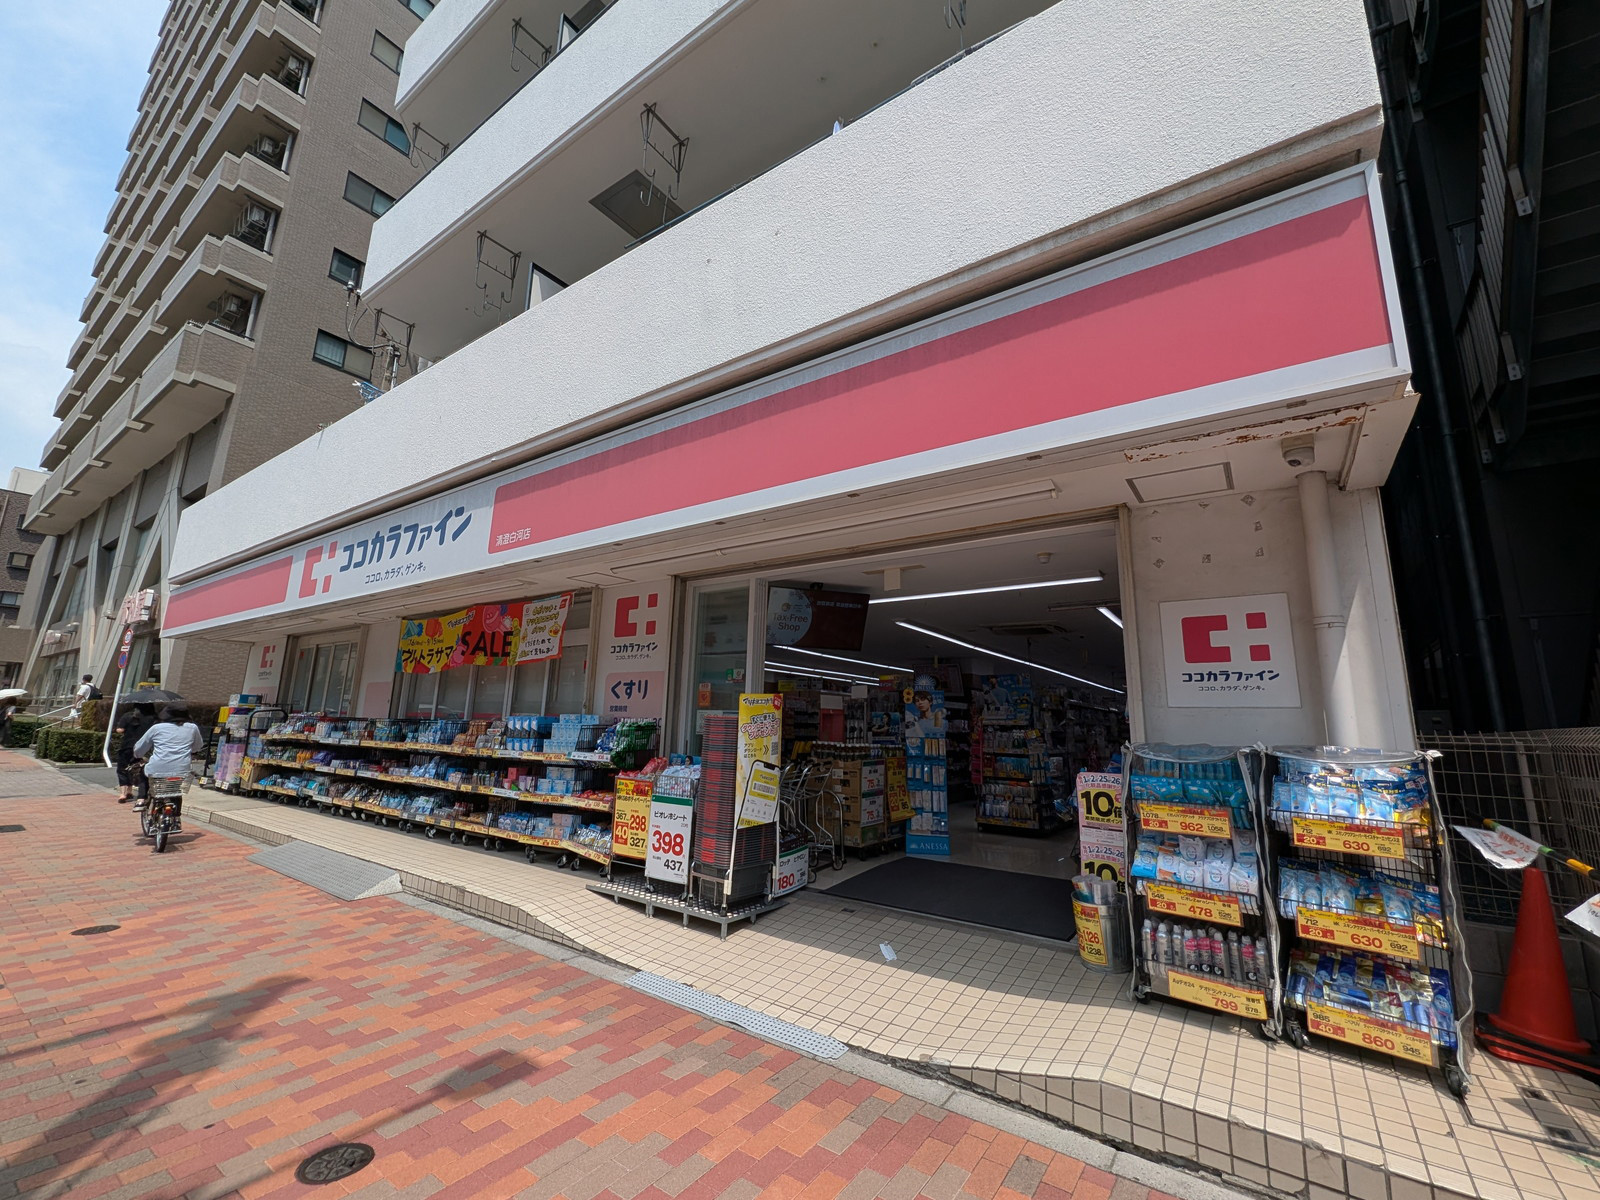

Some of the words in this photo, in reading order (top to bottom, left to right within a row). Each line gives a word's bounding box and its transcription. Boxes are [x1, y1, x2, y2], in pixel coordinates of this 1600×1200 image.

[339, 506, 473, 573] ココカラファイン
[495, 527, 531, 547] 清澄白河店
[365, 560, 427, 585] ココロ、カラダ、ゲンキ。
[773, 613, 808, 623] Tax-Free
[778, 622, 801, 633] Shop
[461, 630, 514, 658] SALE
[610, 642, 659, 654] ココカラファイン
[1181, 670, 1280, 683] ココカラファイン
[610, 679, 649, 700] くすり
[1198, 684, 1265, 693] ココロ、カラダ、ゲンキ。
[1080, 790, 1115, 818] 10
[629, 814, 647, 832] 298
[1180, 821, 1204, 833] 962
[616, 825, 628, 839] 40
[629, 836, 646, 848] 327
[652, 829, 685, 857] 398
[919, 842, 949, 851] ANESSA
[1303, 836, 1317, 845] 20
[1342, 839, 1370, 852] 630
[1377, 845, 1392, 853] 692
[663, 858, 682, 872] 437
[777, 873, 795, 891] 180
[1156, 900, 1167, 909] 20
[1188, 904, 1213, 918] 478
[1304, 916, 1318, 926] 712
[1309, 928, 1323, 937] 20
[1350, 933, 1383, 949] 630
[1389, 941, 1408, 951] 692
[1211, 996, 1238, 1012] 799
[1312, 1012, 1330, 1023] 985
[1318, 1023, 1333, 1034] 40
[1362, 1032, 1396, 1051] 860
[1402, 1044, 1421, 1056] 945
